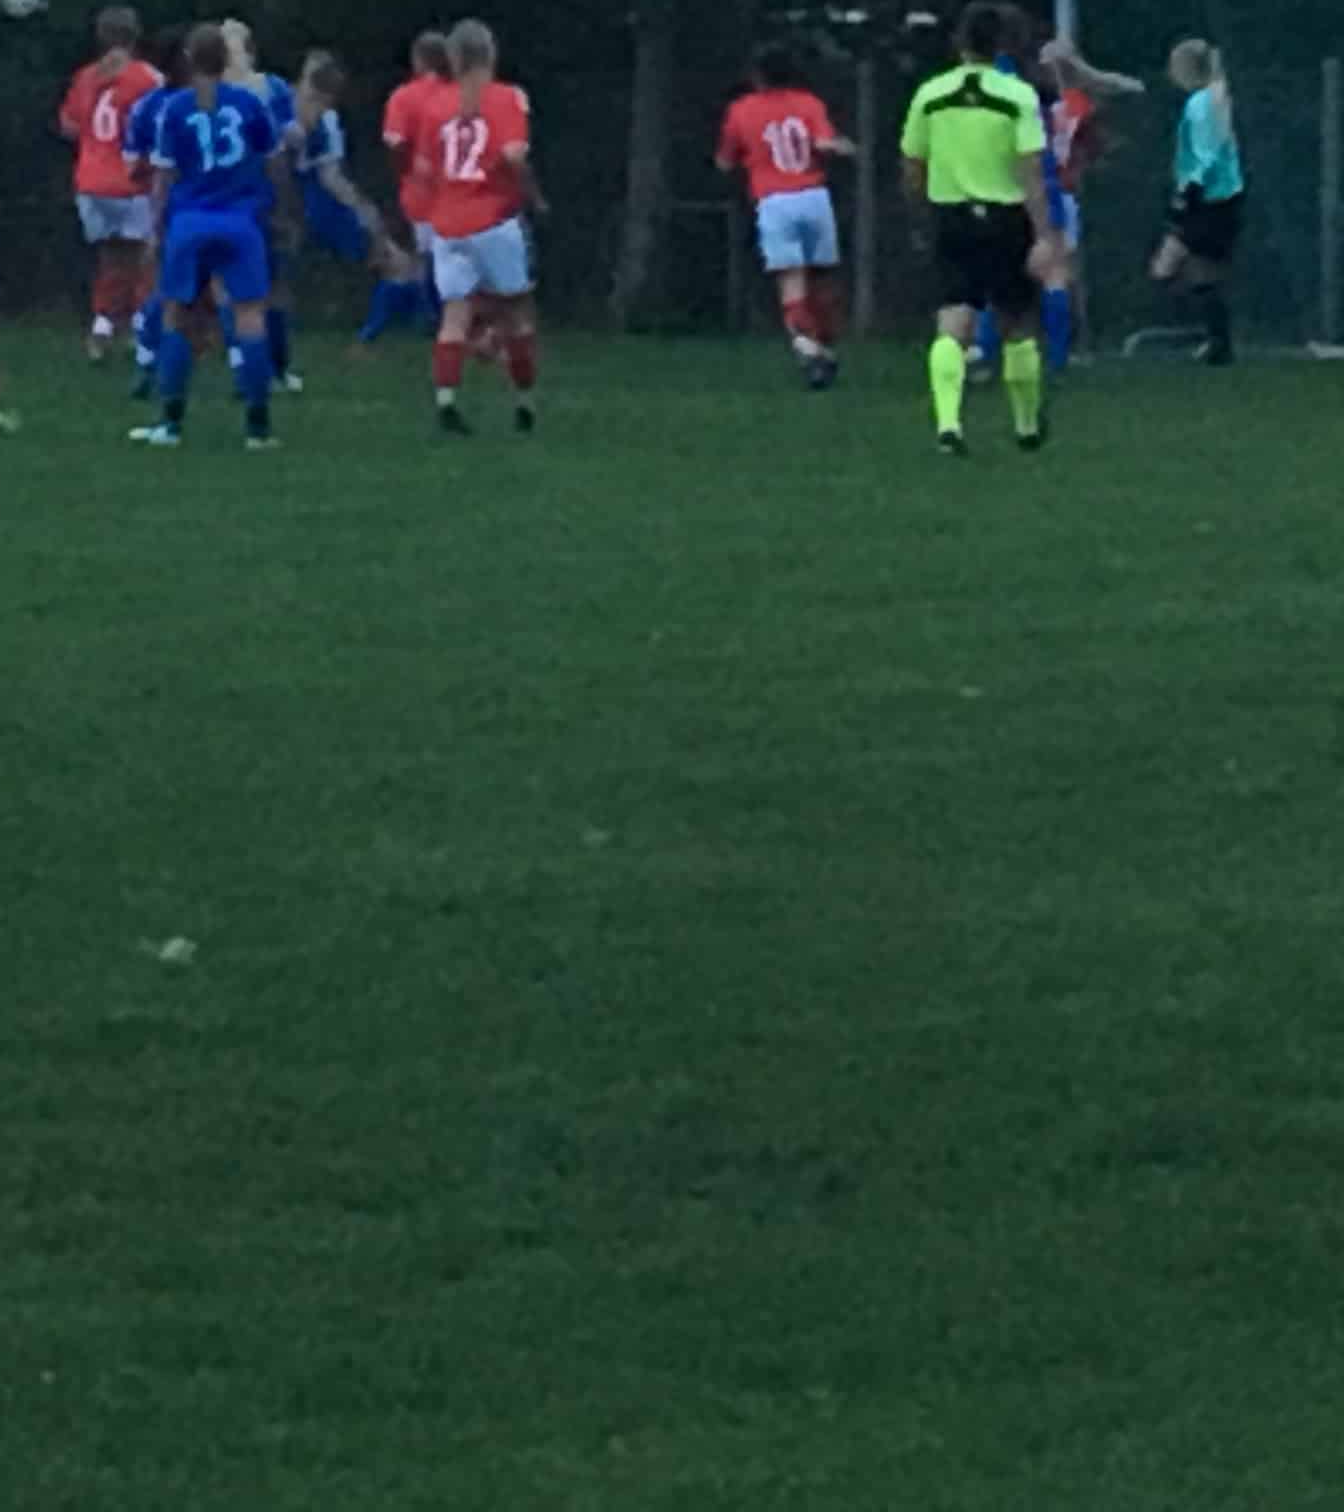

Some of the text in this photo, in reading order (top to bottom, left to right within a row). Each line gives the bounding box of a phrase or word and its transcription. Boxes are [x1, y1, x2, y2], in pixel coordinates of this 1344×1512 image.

[94, 89, 118, 141] 6
[187, 105, 245, 172] 13
[763, 116, 812, 174] 10
[441, 118, 488, 182] 12
